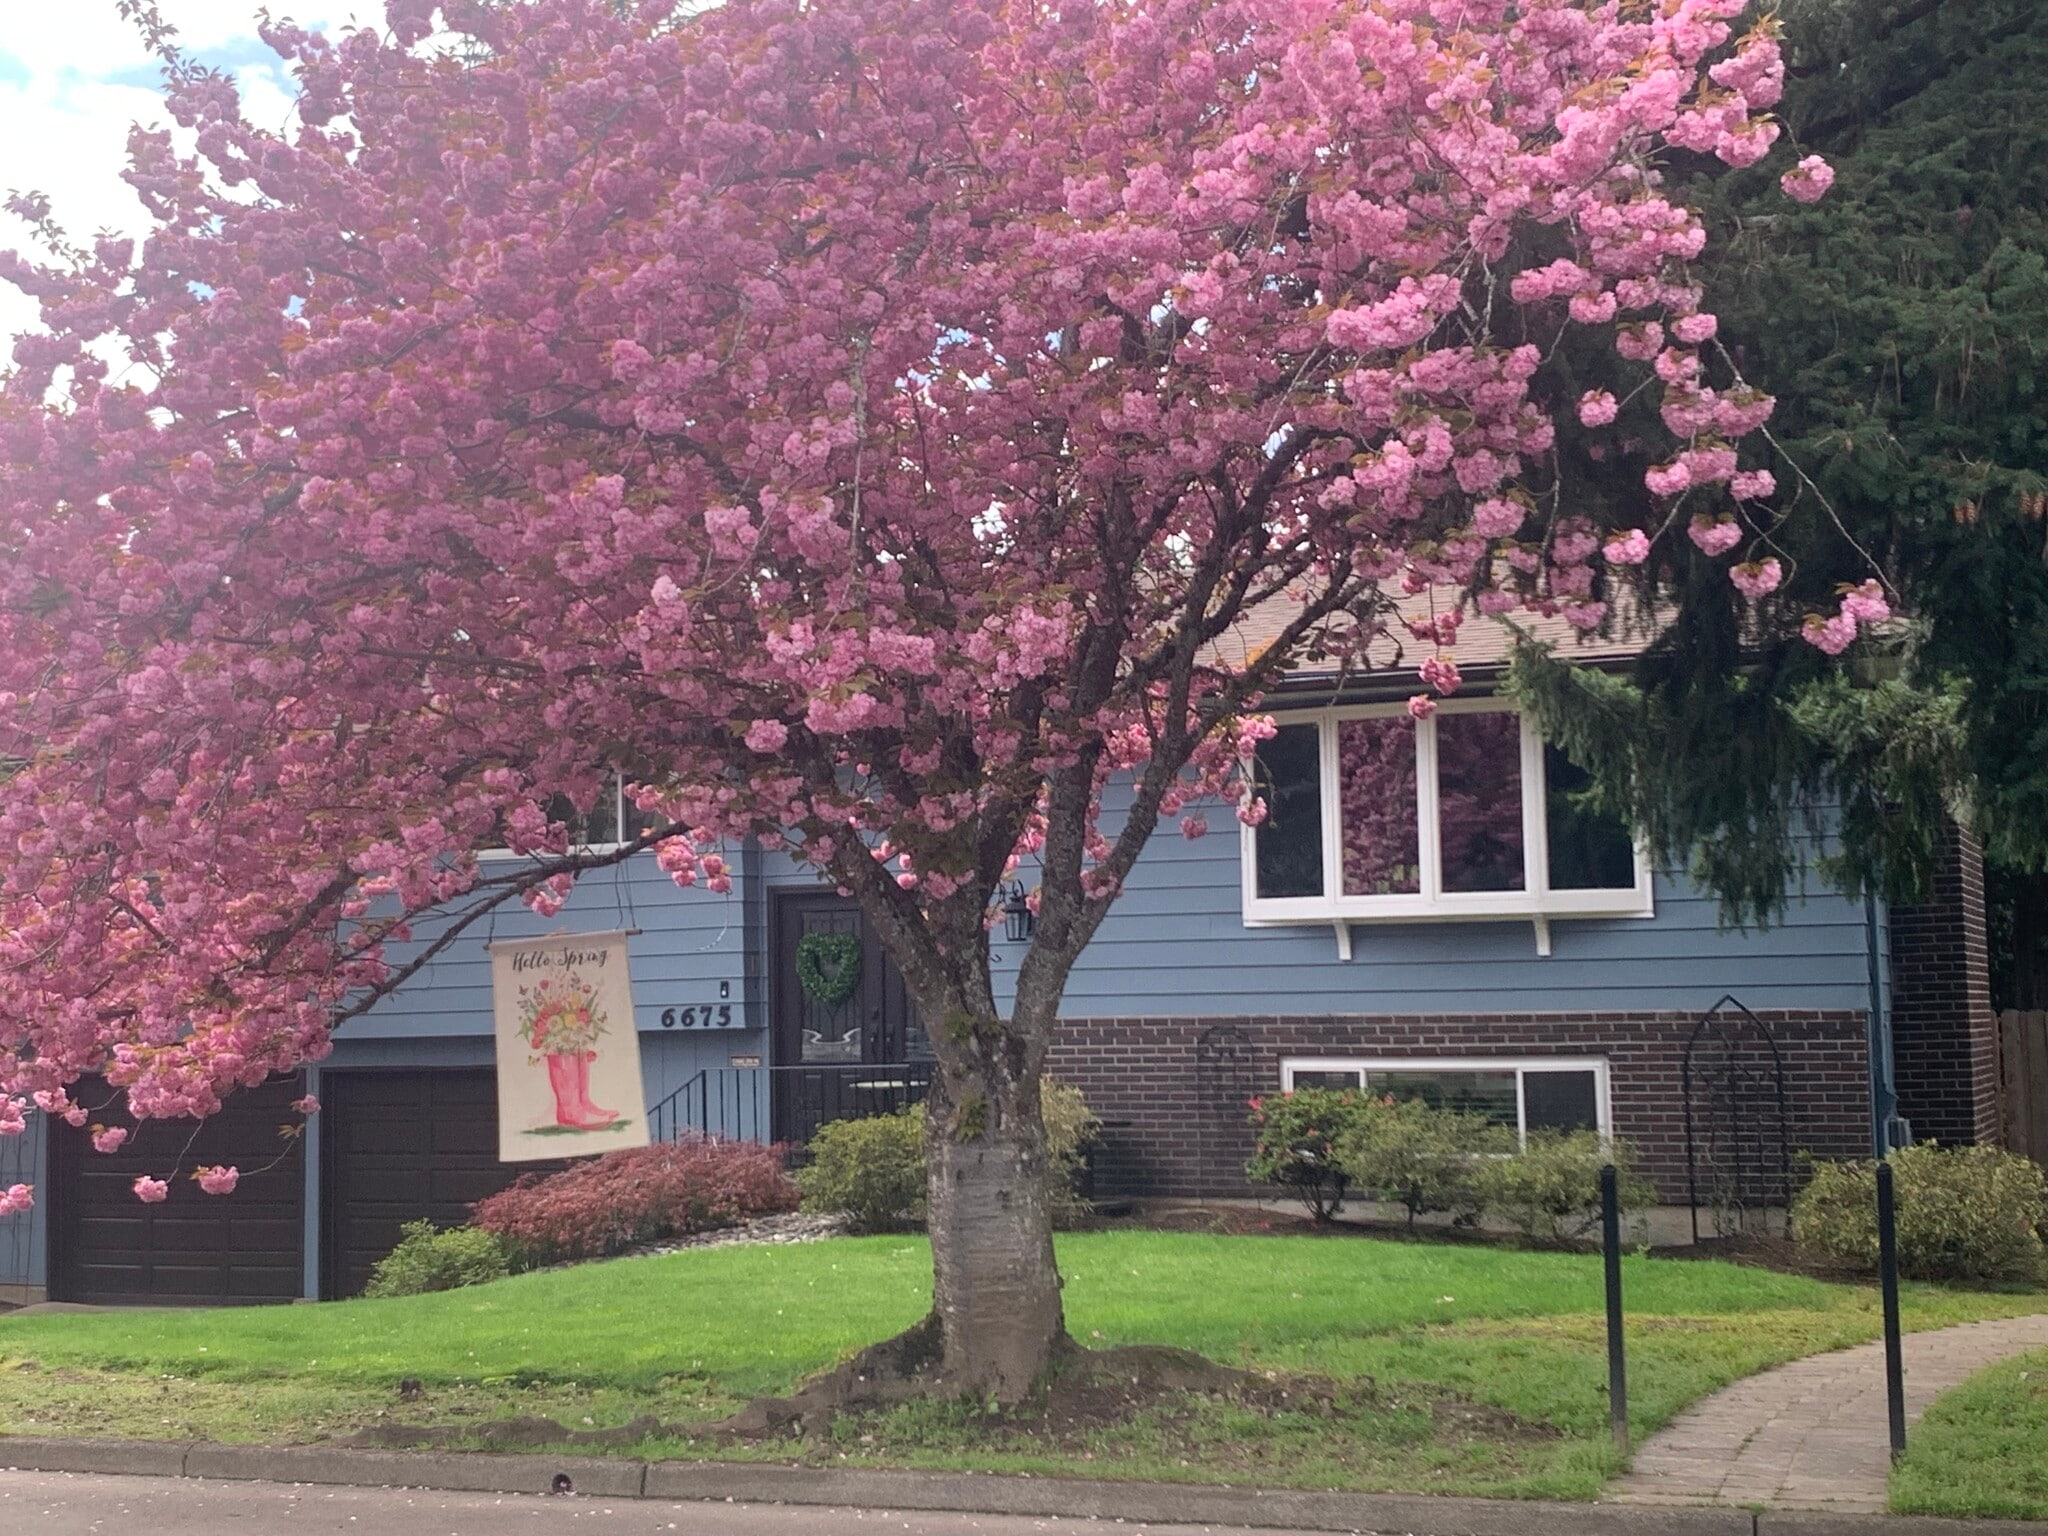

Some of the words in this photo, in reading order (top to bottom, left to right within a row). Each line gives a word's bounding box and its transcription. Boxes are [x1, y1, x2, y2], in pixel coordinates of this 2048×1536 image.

[512, 951, 550, 972] Hello
[557, 947, 607, 971] Spring
[661, 1005, 731, 1028] 6675
